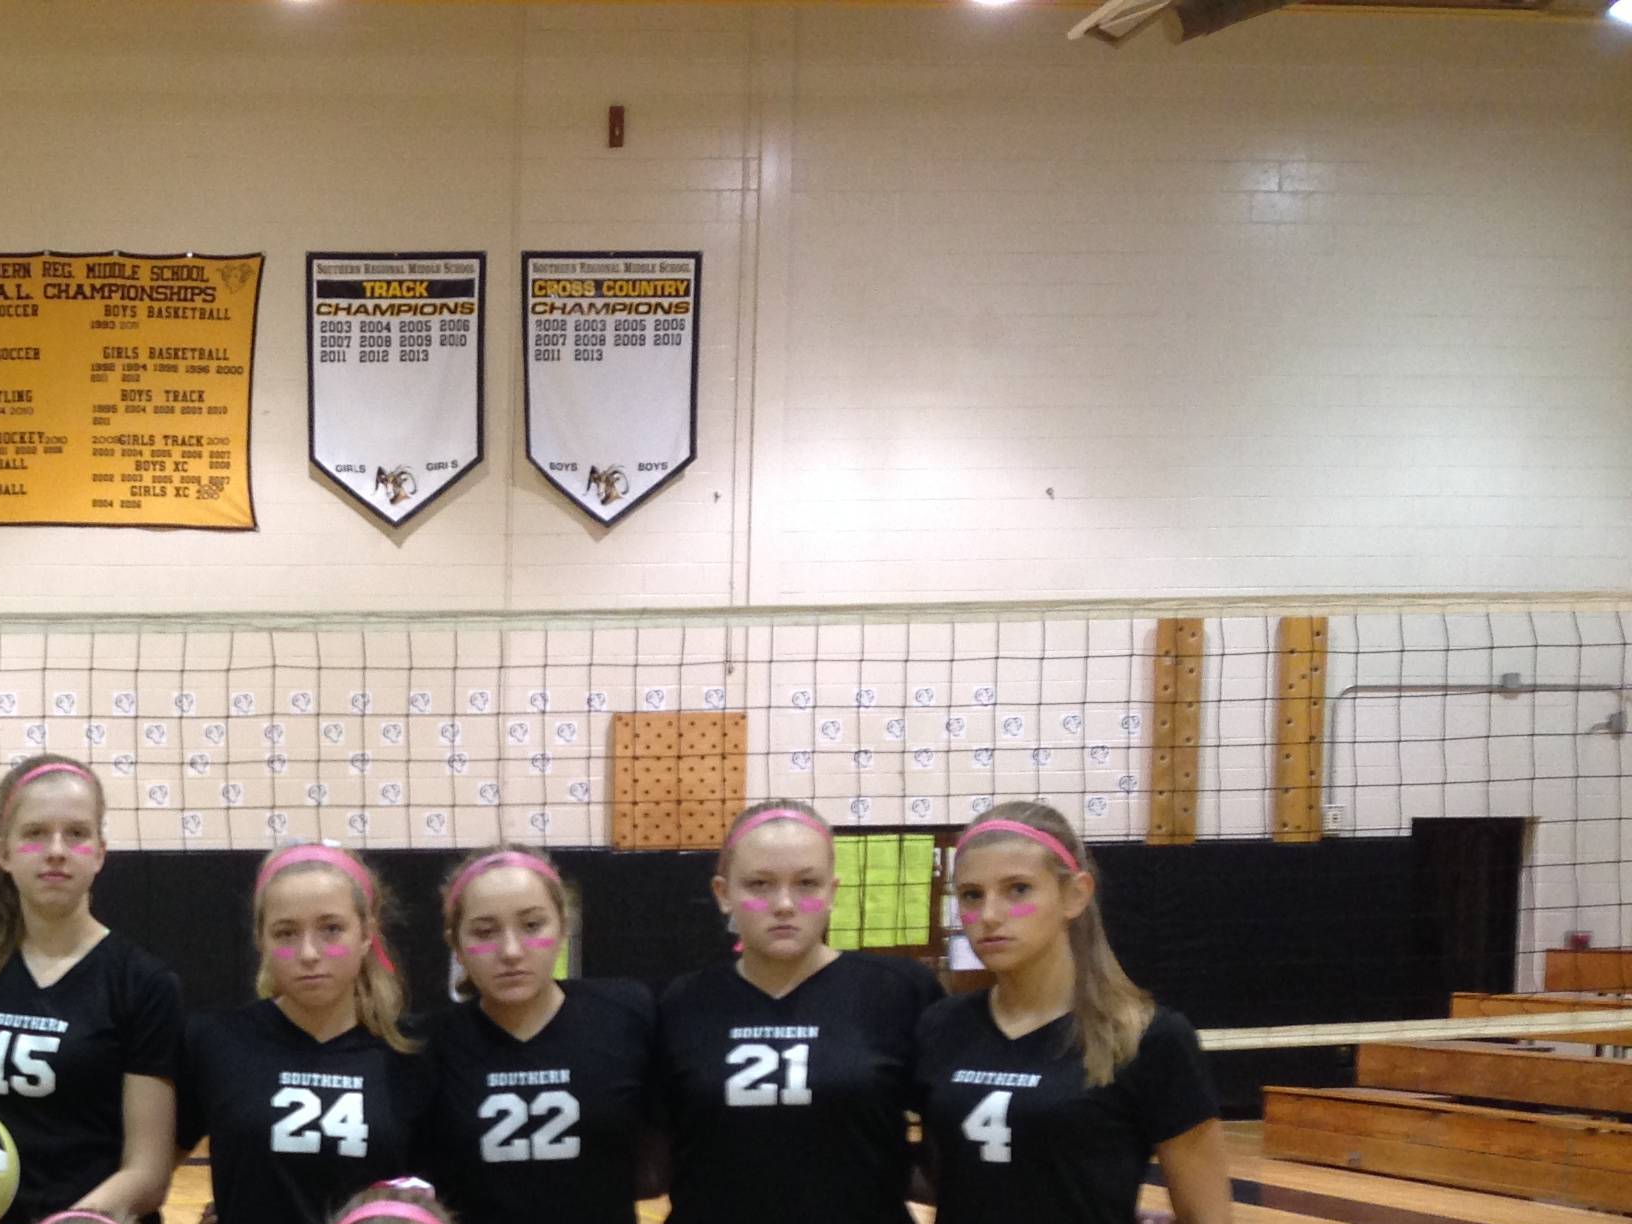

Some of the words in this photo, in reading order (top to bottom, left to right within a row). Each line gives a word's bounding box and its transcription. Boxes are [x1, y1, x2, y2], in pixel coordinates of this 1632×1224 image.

[42, 262, 74, 278] REG.
[86, 263, 140, 281] MIDDLE
[150, 265, 210, 282] SCHOOL
[43, 284, 217, 303] CHAMPIONSHIPS
[362, 280, 430, 297] TRACK
[533, 280, 596, 297] CROSS
[602, 280, 689, 296] COUNTRY
[104, 304, 137, 318] BOYS
[147, 305, 231, 320] BASKETBALL
[315, 302, 476, 316] CHAMPIONS
[531, 301, 690, 315] CHAMPIONS
[320, 321, 352, 333] 2003
[359, 321, 392, 333] 2004
[399, 320, 432, 333] 2005
[439, 319, 470, 332] 2006
[535, 319, 567, 332] 2002
[574, 319, 607, 331] 2003
[614, 319, 646, 331] 2005
[654, 318, 686, 331] 2006
[320, 335, 352, 348] 2007
[359, 335, 392, 348] 2008
[399, 335, 432, 346] 2009
[439, 334, 467, 346] 2010
[535, 334, 567, 346] 2007
[574, 334, 606, 346] 2008
[614, 333, 646, 346] 2009
[653, 333, 682, 346] 2010
[103, 346, 139, 359] GIRLS
[148, 347, 230, 361] BASKETBALL
[320, 350, 346, 362] 2011
[359, 350, 389, 363] 2012
[399, 350, 429, 362] 2013
[534, 349, 560, 361] 2011
[574, 349, 603, 361] 2013
[121, 389, 152, 402] BOYS
[163, 389, 205, 403] TRACK
[119, 434, 156, 447] GIRLS
[163, 434, 204, 447] TRACK
[135, 460, 166, 472] BOYS
[173, 460, 189, 472] XC
[335, 464, 366, 474] GIRLS
[549, 463, 578, 472] BOYS
[637, 462, 668, 471] BOYS
[130, 485, 167, 497] GIRLS
[174, 486, 190, 498] XC
[730, 1025, 820, 1040] SOUTHERN
[279, 1071, 364, 1089] SOUTHERN
[487, 1069, 571, 1087] SOUTHERN
[725, 1043, 813, 1106] 21
[952, 1070, 1042, 1088] SOUTHERN
[271, 1087, 368, 1158] 24
[478, 1091, 581, 1162] 22
[962, 1090, 1013, 1162] 4
